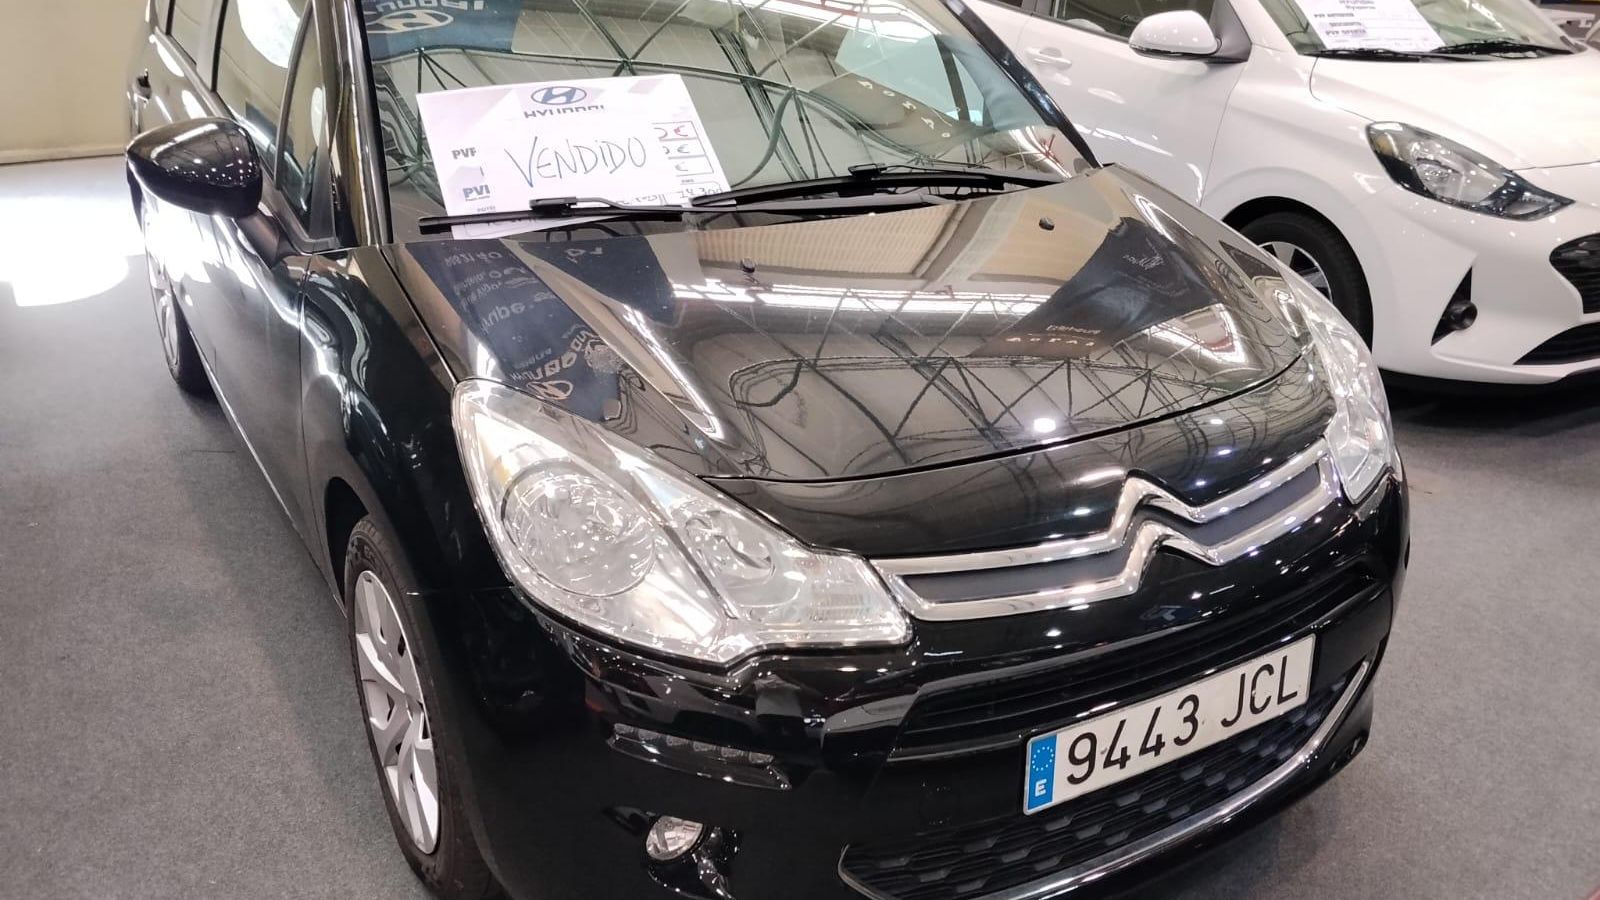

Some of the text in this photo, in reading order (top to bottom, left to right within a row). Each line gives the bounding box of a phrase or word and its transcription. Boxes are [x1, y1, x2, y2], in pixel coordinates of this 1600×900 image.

[503, 136, 647, 188] VENDIDO
[1034, 655, 1299, 798] E 9443 JCL
